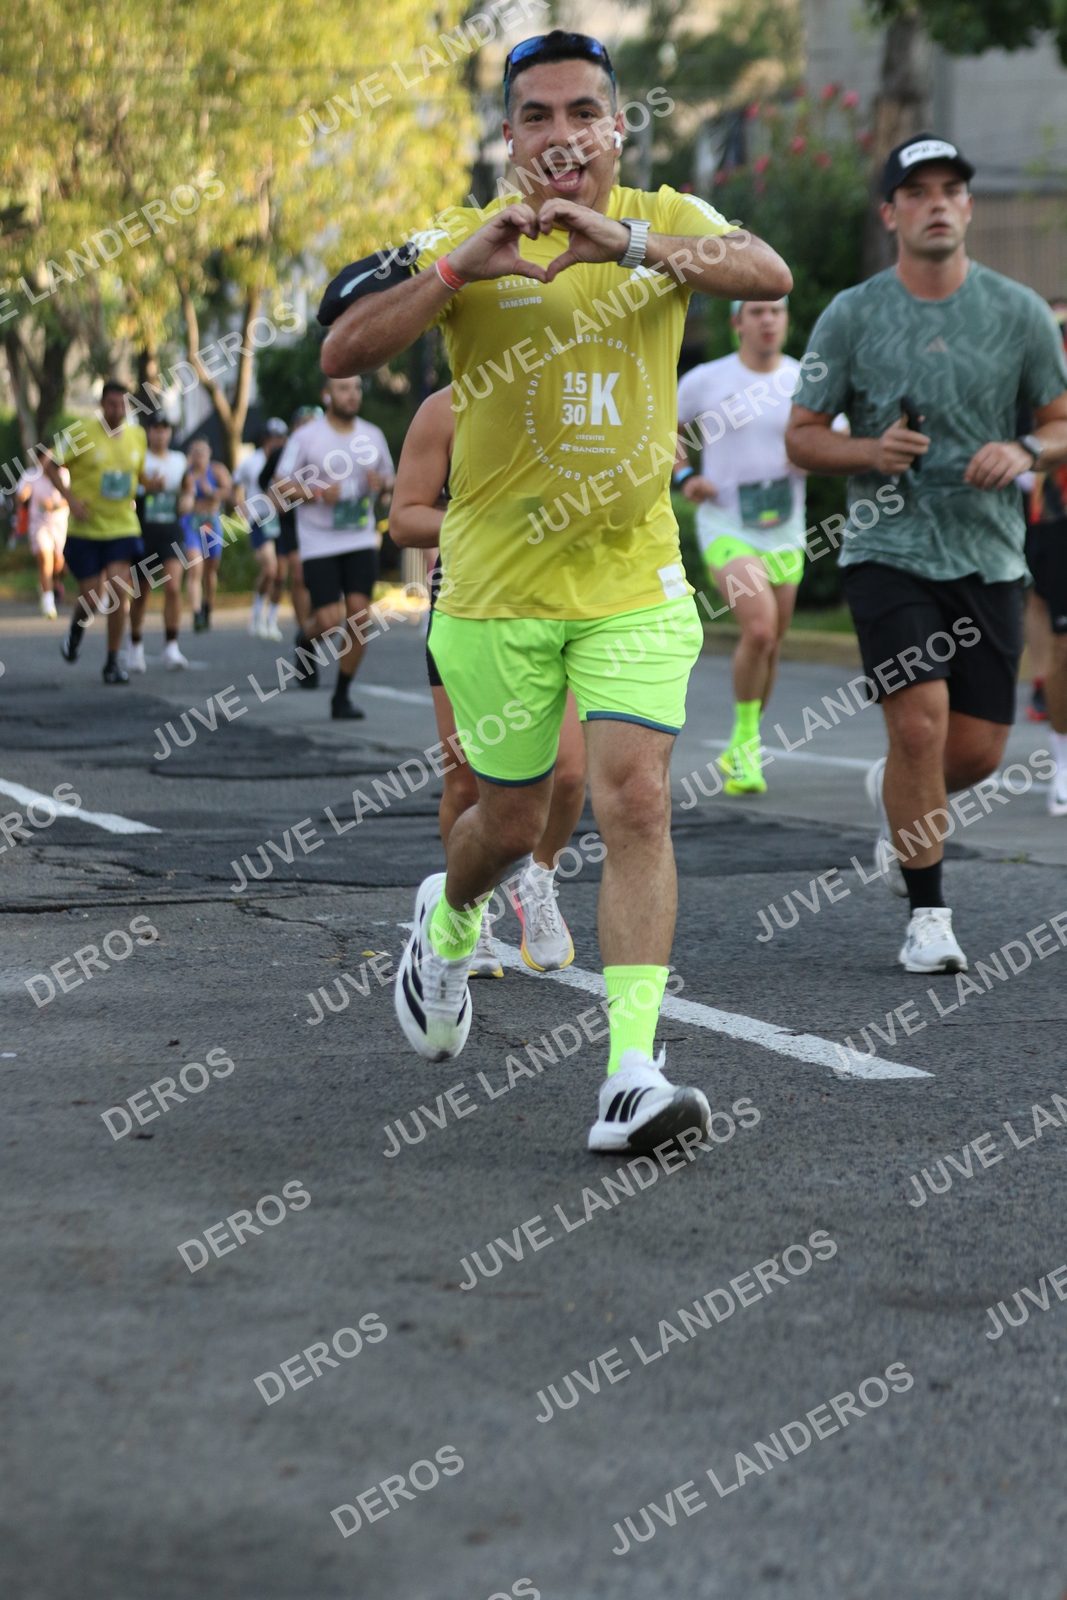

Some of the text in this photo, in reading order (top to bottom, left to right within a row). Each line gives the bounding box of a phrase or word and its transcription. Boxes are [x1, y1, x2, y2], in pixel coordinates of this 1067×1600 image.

[500, 297, 543, 309] SAMSUNG
[563, 371, 588, 395] 15
[590, 372, 622, 426] K
[562, 403, 587, 426] 30
[572, 446, 617, 454] BANORTE
